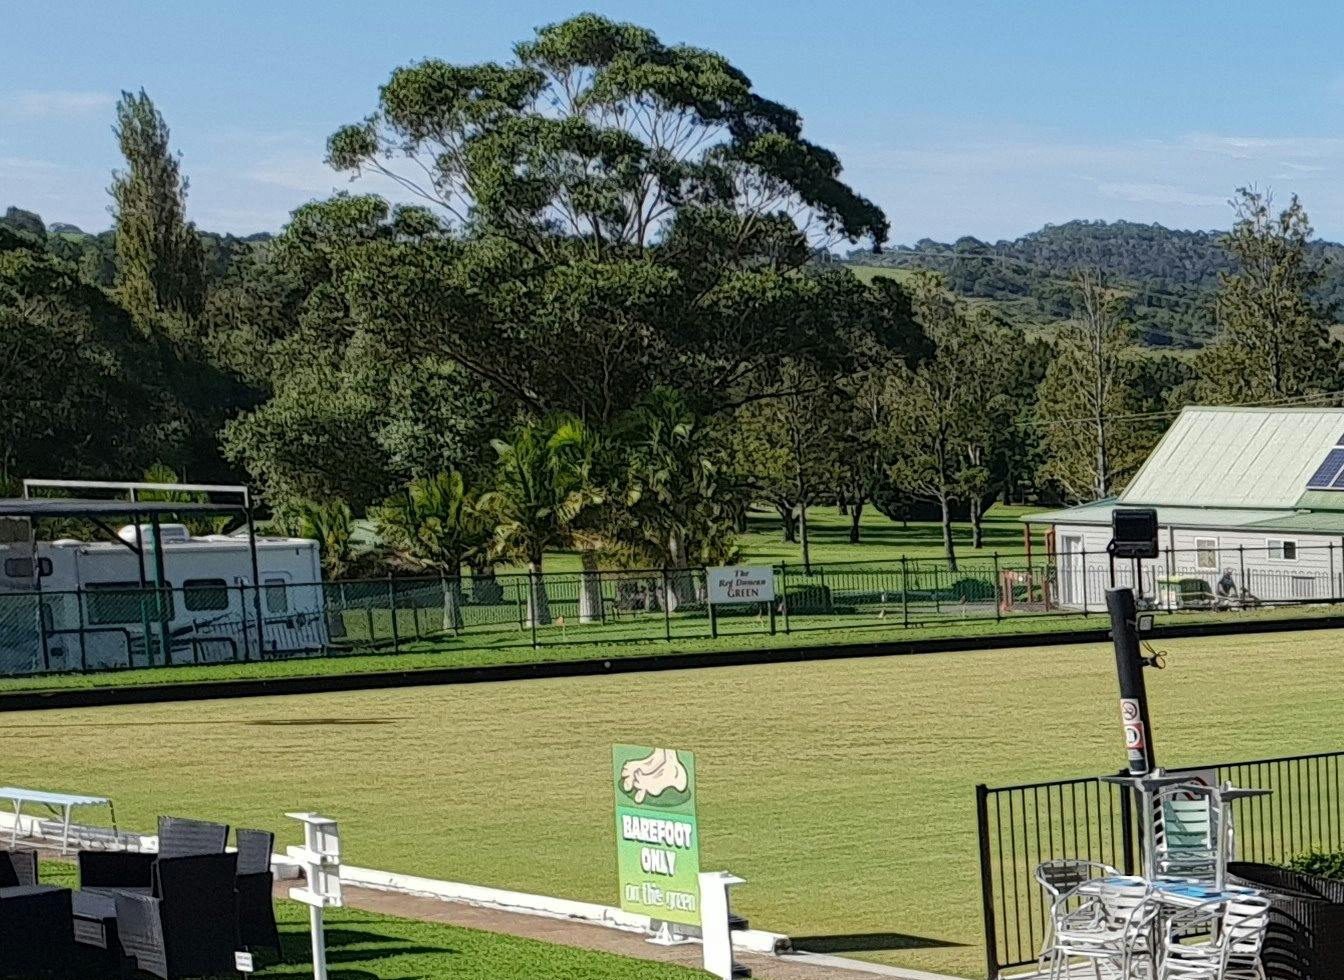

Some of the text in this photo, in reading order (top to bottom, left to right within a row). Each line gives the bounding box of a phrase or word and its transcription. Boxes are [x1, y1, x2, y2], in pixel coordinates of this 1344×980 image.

[727, 588, 759, 598] GREEN
[736, 578, 766, 587] Duncan
[622, 814, 693, 849] BAREFOOT
[640, 847, 677, 877] ONLY
[626, 881, 696, 912] on the green
